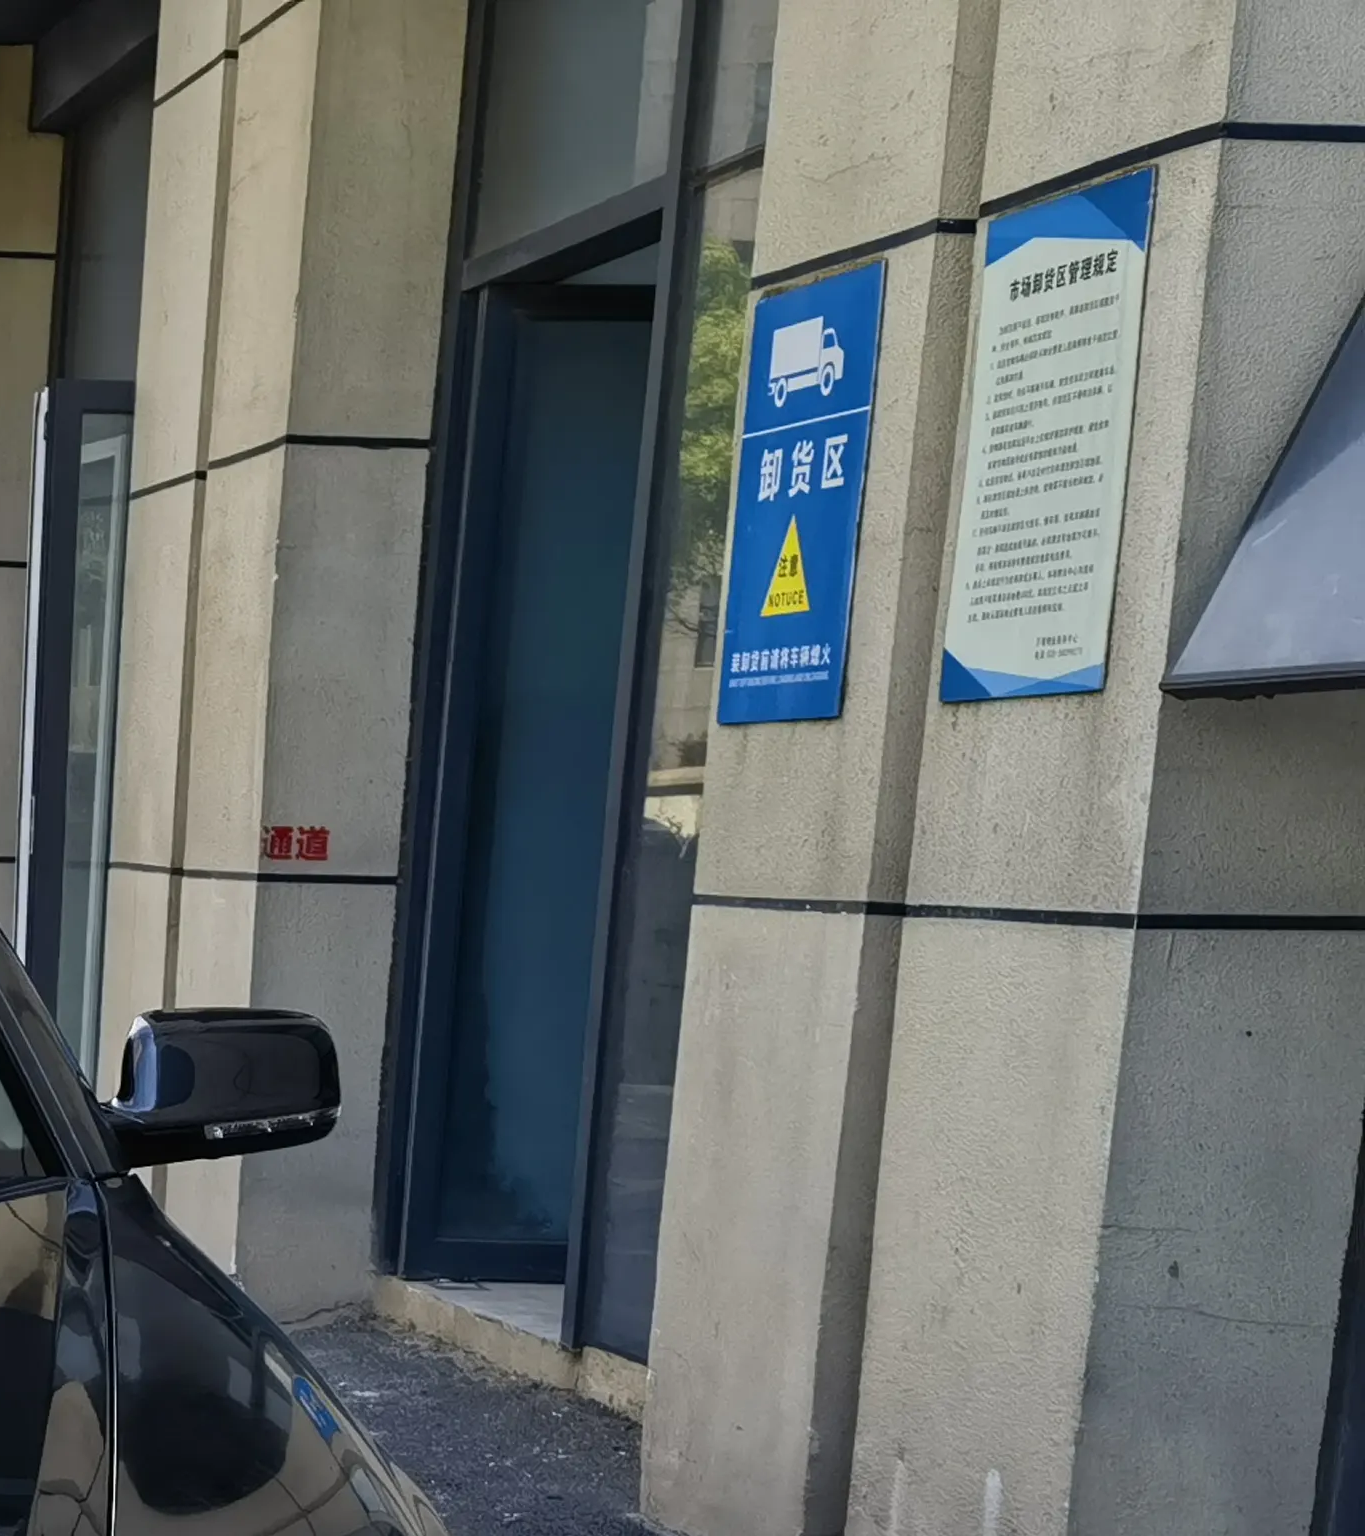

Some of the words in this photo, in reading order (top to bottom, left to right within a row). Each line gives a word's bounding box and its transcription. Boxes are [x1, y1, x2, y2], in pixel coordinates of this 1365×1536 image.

[1010, 249, 1118, 301] 市场卸货区管理规定
[757, 433, 848, 502] 卸货区
[777, 553, 799, 578] 注意
[263, 826, 330, 861] 通道
